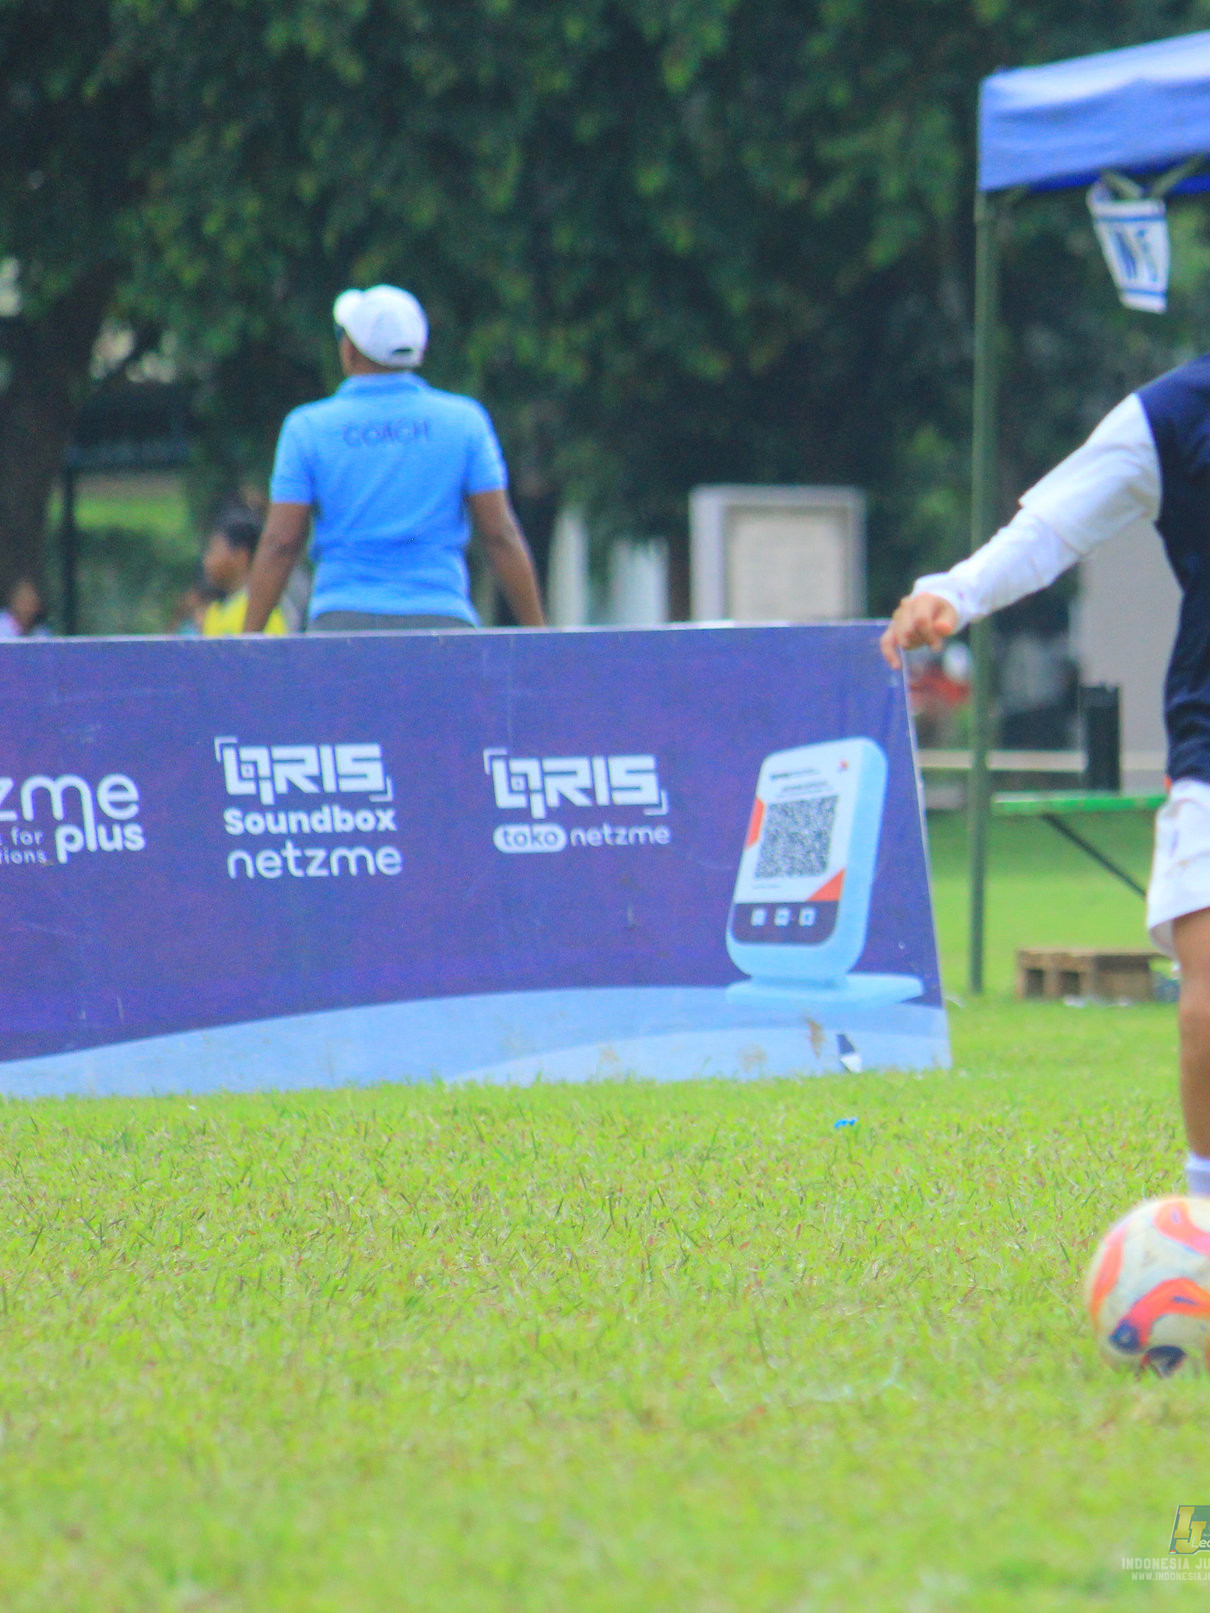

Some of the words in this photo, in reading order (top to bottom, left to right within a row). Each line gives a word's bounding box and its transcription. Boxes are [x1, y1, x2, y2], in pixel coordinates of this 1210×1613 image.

[222, 742, 387, 806] QRIS
[492, 755, 660, 819] QRIS
[223, 804, 398, 835] Soundbox
[504, 824, 559, 846] toko
[570, 822, 671, 847] netzme
[55, 823, 146, 864] plus
[227, 839, 403, 879] netzme
